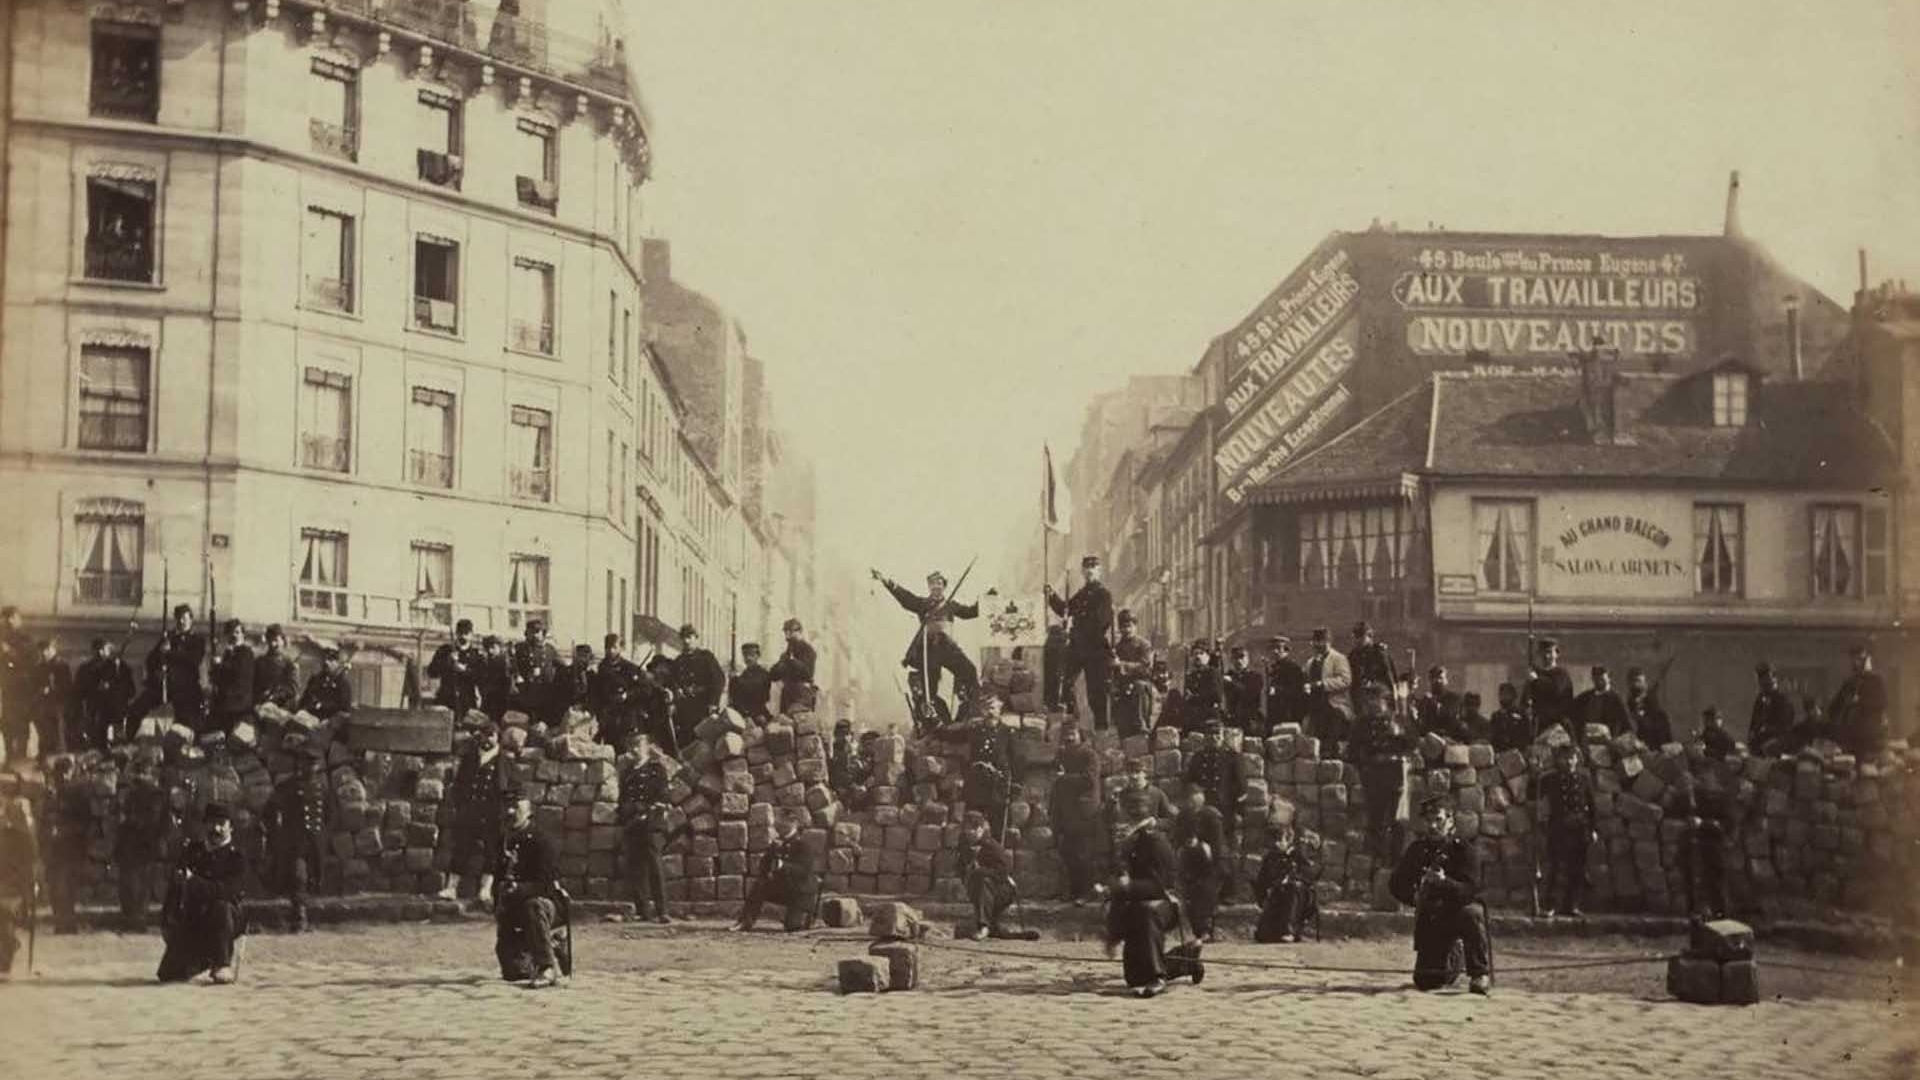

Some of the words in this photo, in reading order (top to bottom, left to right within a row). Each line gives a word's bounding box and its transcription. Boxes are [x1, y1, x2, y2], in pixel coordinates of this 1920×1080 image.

[1538, 252, 1593, 272] Prince
[1407, 275, 1464, 304] AUX
[1487, 276, 1697, 309] TRAVAILLEURS
[1249, 272, 1360, 382] TRAVAILLEURS
[1560, 528, 1578, 548] AU
[1579, 516, 1621, 537] GRAND
